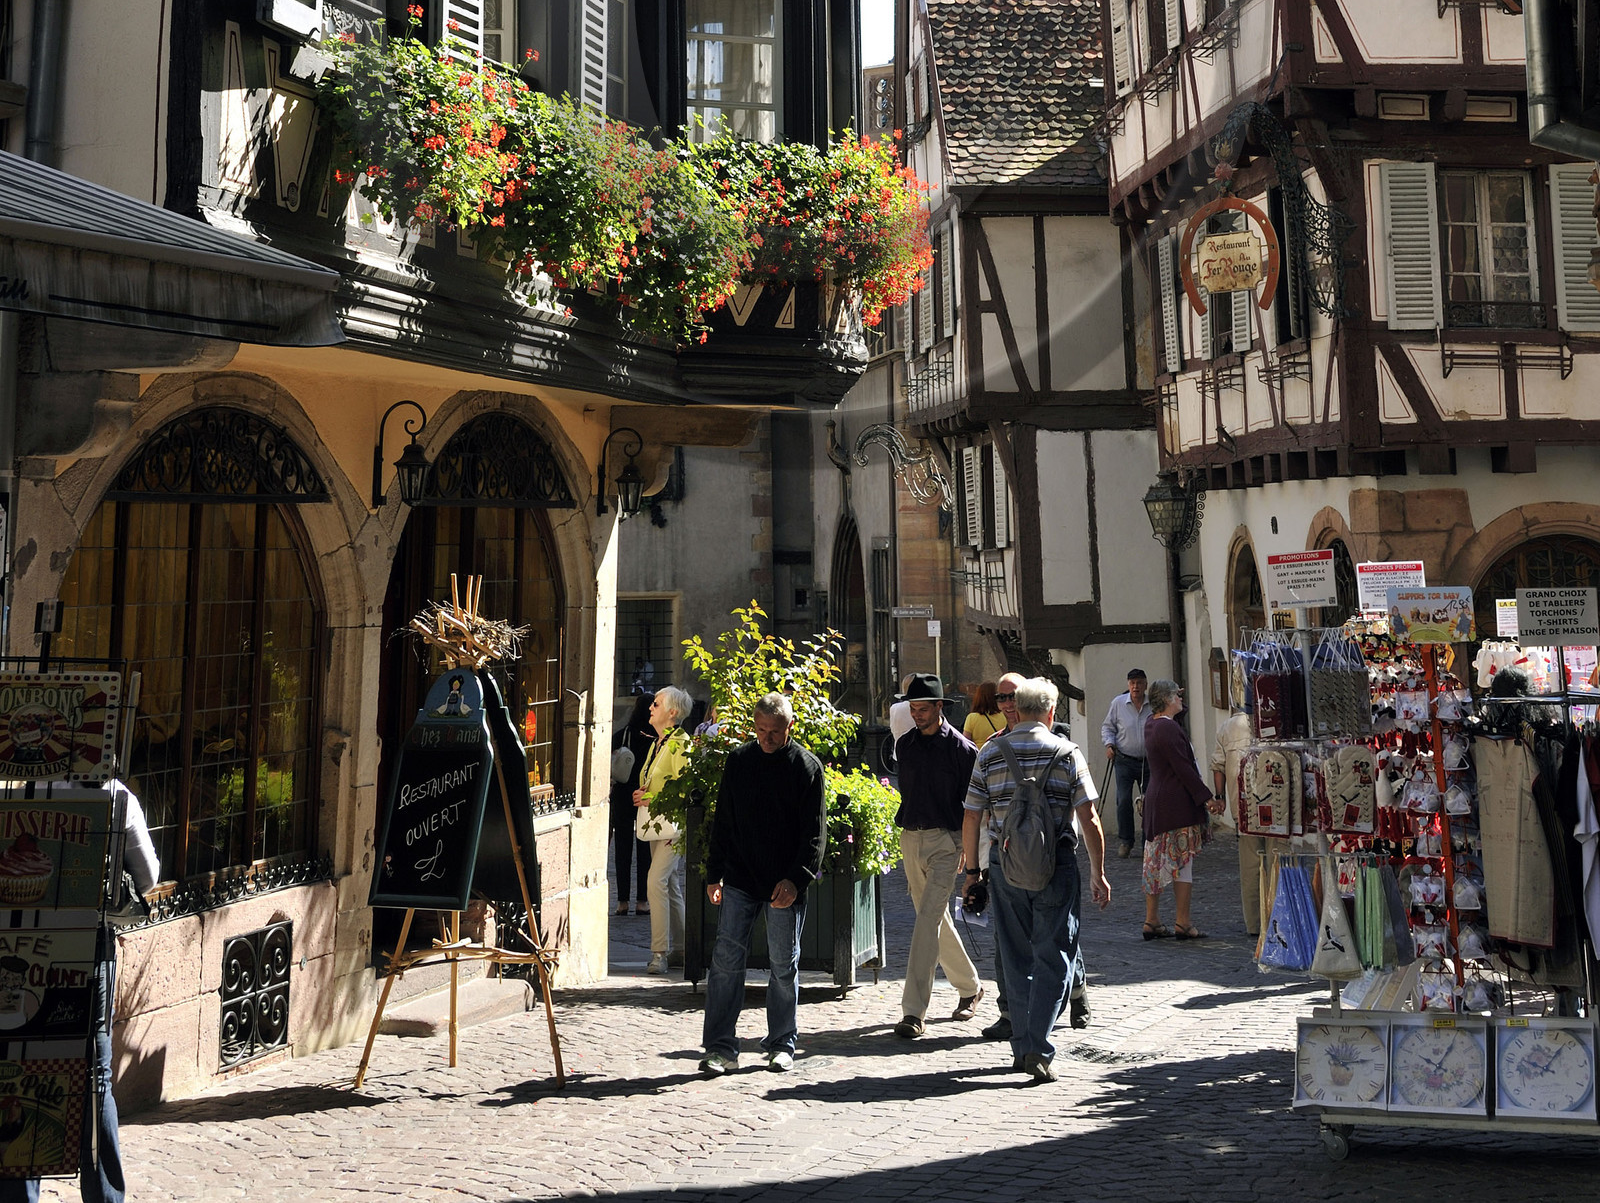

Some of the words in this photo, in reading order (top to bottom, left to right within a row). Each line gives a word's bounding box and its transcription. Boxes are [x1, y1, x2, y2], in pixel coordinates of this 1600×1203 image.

[1207, 237, 1251, 253] Restaurant
[1239, 252, 1251, 261] Au
[1202, 259, 1222, 280] Fer
[1219, 256, 1257, 279] Rouge
[1279, 552, 1319, 561] PROMOTIONS
[1525, 590, 1557, 599] GRAND
[1558, 589, 1587, 597] CHOIX
[1529, 600, 1541, 608] DE
[1542, 599, 1586, 607] TABLIERS
[1530, 608, 1578, 617] TORCHONS
[1537, 618, 1579, 626] T-SHIRTS
[1520, 628, 1547, 636] LINGE
[398, 762, 480, 810] RESTAURANT
[405, 799, 467, 846] OUVERT
